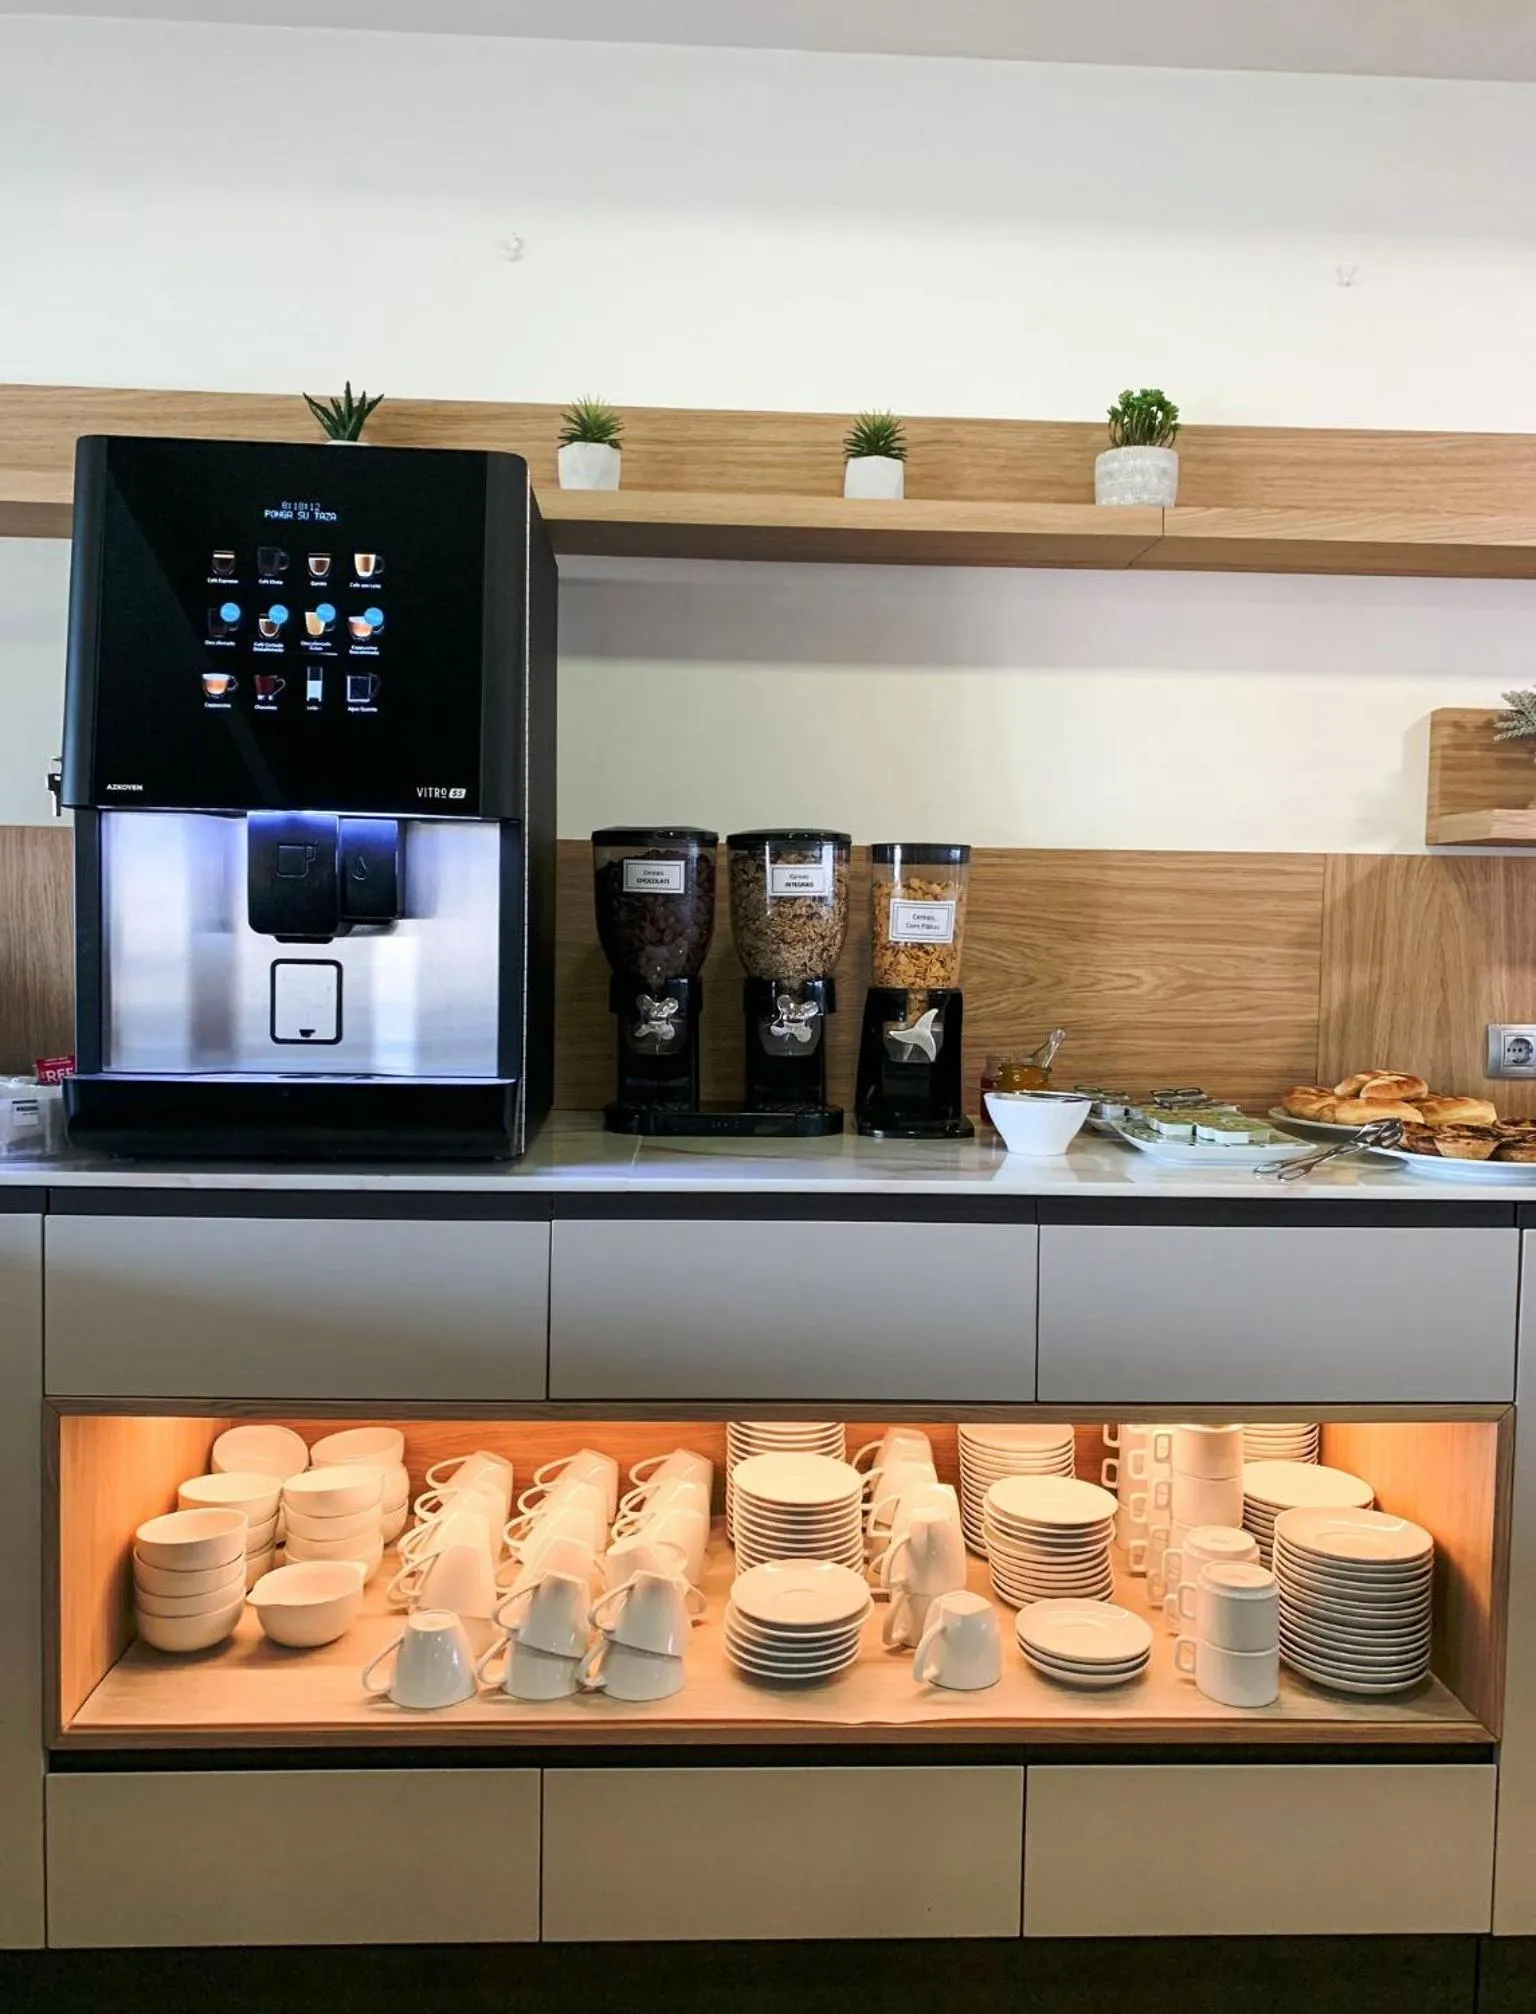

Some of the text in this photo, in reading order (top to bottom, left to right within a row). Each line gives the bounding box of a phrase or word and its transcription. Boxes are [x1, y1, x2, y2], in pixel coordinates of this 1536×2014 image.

[264, 509, 337, 521] PONGA SU TAZA
[106, 783, 143, 791] AZKOYEN
